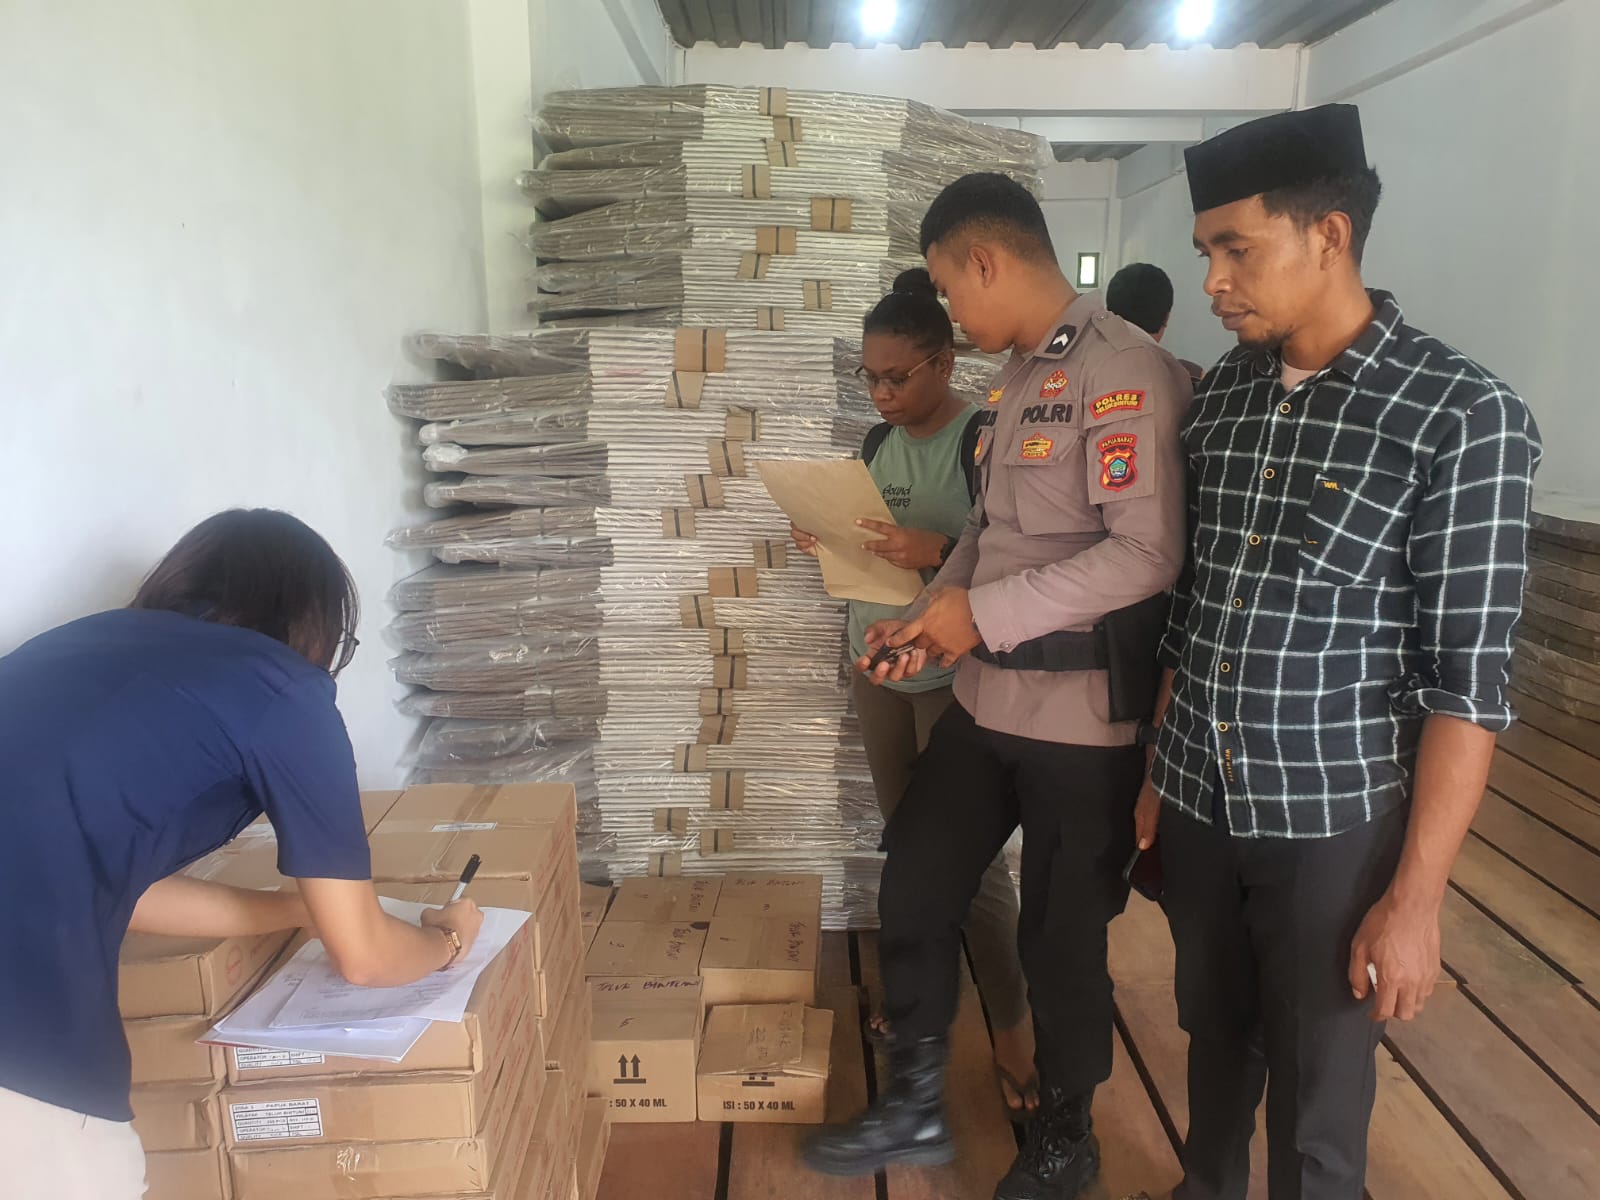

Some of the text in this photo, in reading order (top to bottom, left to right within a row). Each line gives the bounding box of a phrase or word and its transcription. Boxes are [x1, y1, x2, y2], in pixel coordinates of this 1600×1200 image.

[1020, 403, 1073, 425] POLRI
[615, 1099, 627, 1108] 50
[629, 1099, 636, 1108] X
[639, 1099, 650, 1108] 40
[653, 1099, 668, 1108] ML
[723, 1101, 735, 1110] ISI
[744, 1101, 755, 1110] 50
[758, 1101, 765, 1110] X
[767, 1101, 778, 1110] 40
[781, 1101, 796, 1110] ML
